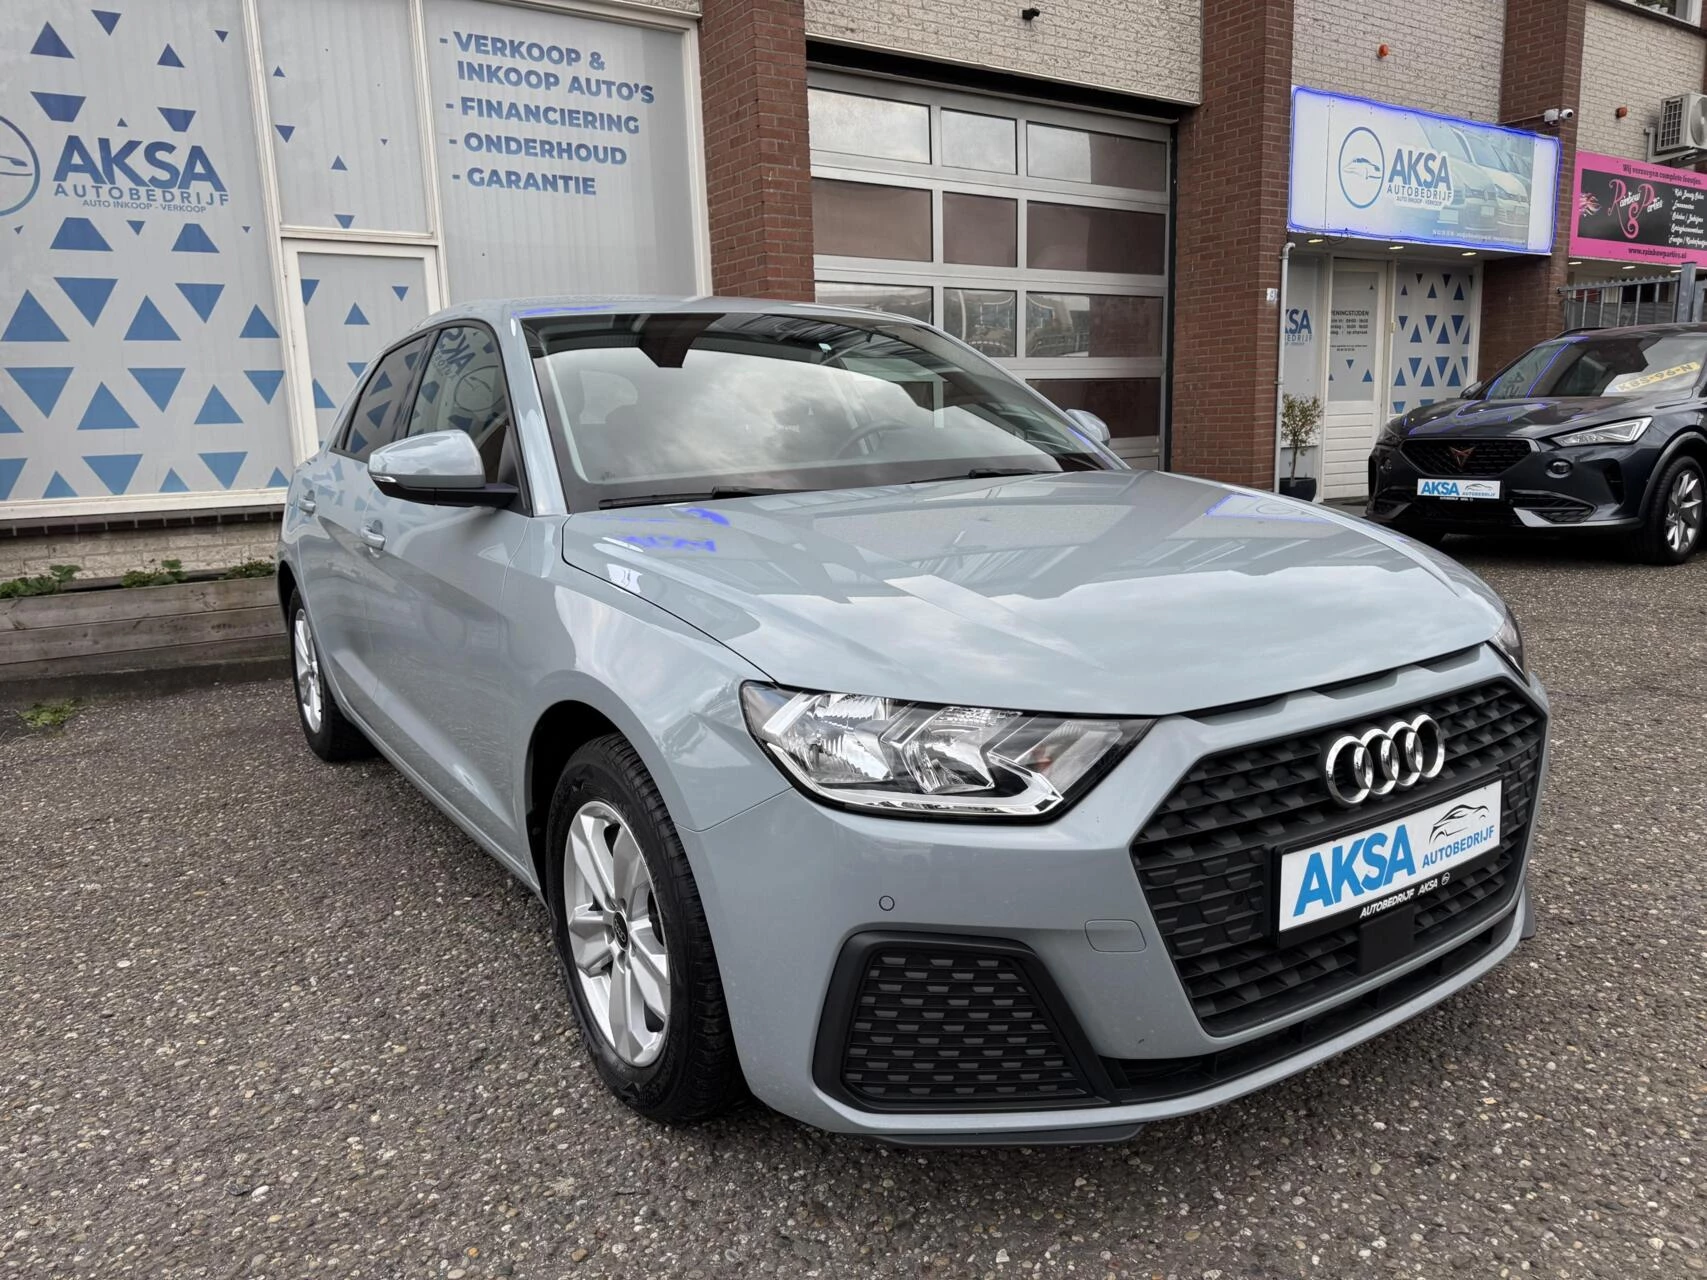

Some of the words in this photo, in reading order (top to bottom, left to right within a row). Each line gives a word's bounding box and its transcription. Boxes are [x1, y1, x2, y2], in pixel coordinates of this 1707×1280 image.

[453, 31, 581, 66] VERKOOP
[589, 52, 606, 71] &
[457, 61, 560, 91] INKOOP
[568, 76, 655, 104] AUTO'S
[461, 96, 640, 135] FINANCIERING
[52, 135, 227, 193] AKSA
[464, 132, 627, 165] ONDERHOUD
[467, 167, 597, 196] GARANTIE
[1388, 148, 1452, 191] AKSA
[53, 181, 230, 207] AUTOBEDRIJF
[82, 197, 111, 209] AUTO
[112, 199, 153, 211] INKOOP
[160, 203, 207, 214] VERKOOP
[1386, 184, 1452, 201] AUTOBEDRIJF
[1421, 481, 1460, 496] AKSA
[1422, 825, 1495, 868] AUTOBEDRIJF
[1293, 824, 1416, 917] AKSA
[1360, 888, 1415, 919] AUTOBEDRIJF
[1417, 878, 1438, 896] AKSA
